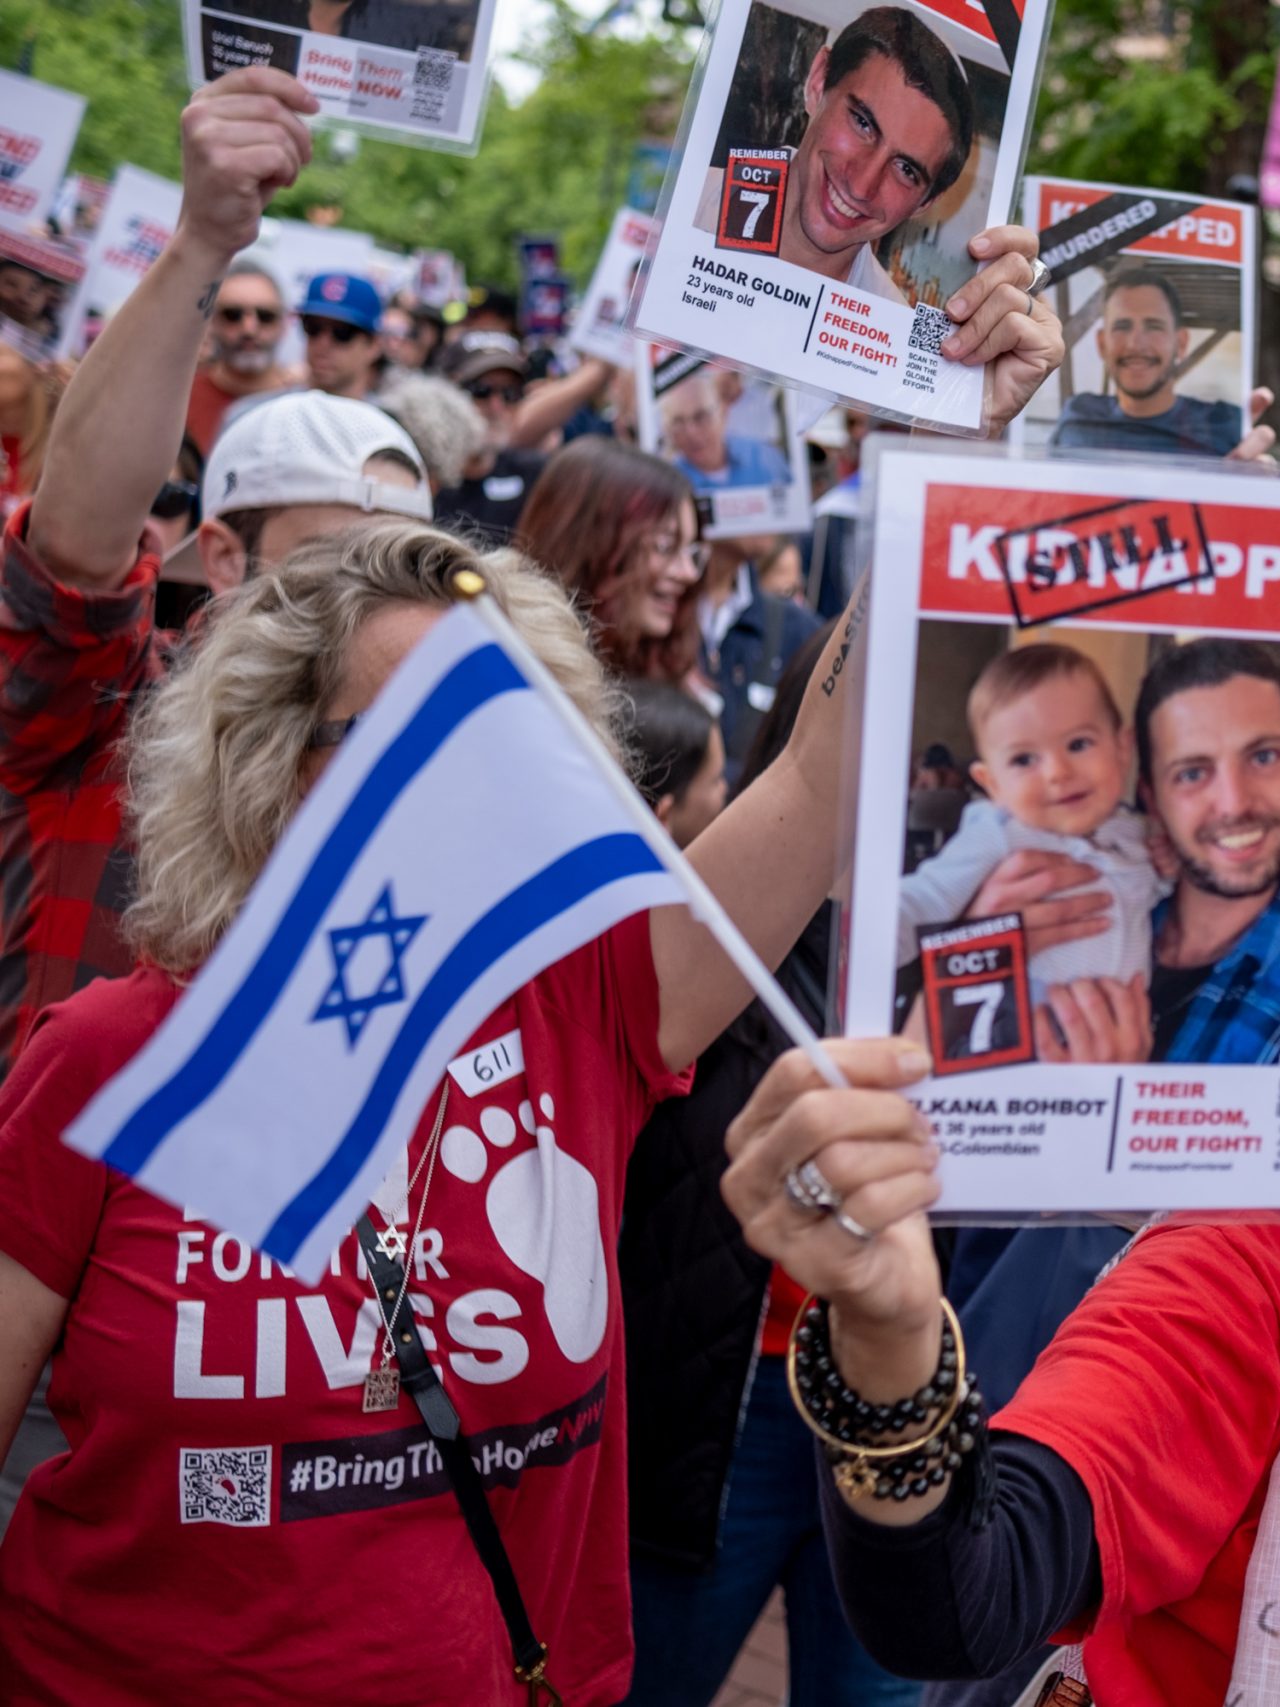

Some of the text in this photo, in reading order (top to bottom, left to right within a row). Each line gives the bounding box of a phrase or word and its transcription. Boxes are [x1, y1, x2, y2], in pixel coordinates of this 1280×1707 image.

[307, 49, 402, 80] Bring Them
[304, 71, 403, 99] Home NOW
[729, 148, 788, 160] REMEMBER
[741, 167, 772, 183] OCT
[740, 190, 770, 239] 7
[1040, 199, 1157, 269] MURDERED
[686, 274, 756, 307] 23 years old
[692, 255, 811, 309] HADAR GOLDIN
[682, 291, 716, 313] Israeli
[830, 292, 871, 317] THEIR
[823, 312, 892, 348] FREEDOM,
[818, 331, 897, 368] OUR FIGHT!
[908, 352, 927, 364] SCAN
[905, 370, 934, 384] GLOBAL
[906, 361, 937, 376] JOIN THE
[1025, 514, 1188, 593] STILL
[921, 915, 1020, 950] REMEMBER
[947, 949, 1000, 976] OCT
[953, 981, 1005, 1054] 7
[473, 1042, 511, 1082] 611
[1136, 1082, 1206, 1099] THEIR
[910, 1099, 1108, 1116] LKANA BOHBOT
[1132, 1109, 1249, 1128] FREEDOM,
[968, 1123, 1015, 1139] years
[1018, 1121, 1046, 1136] old
[1129, 1136, 1262, 1153] OUR FIGHT!
